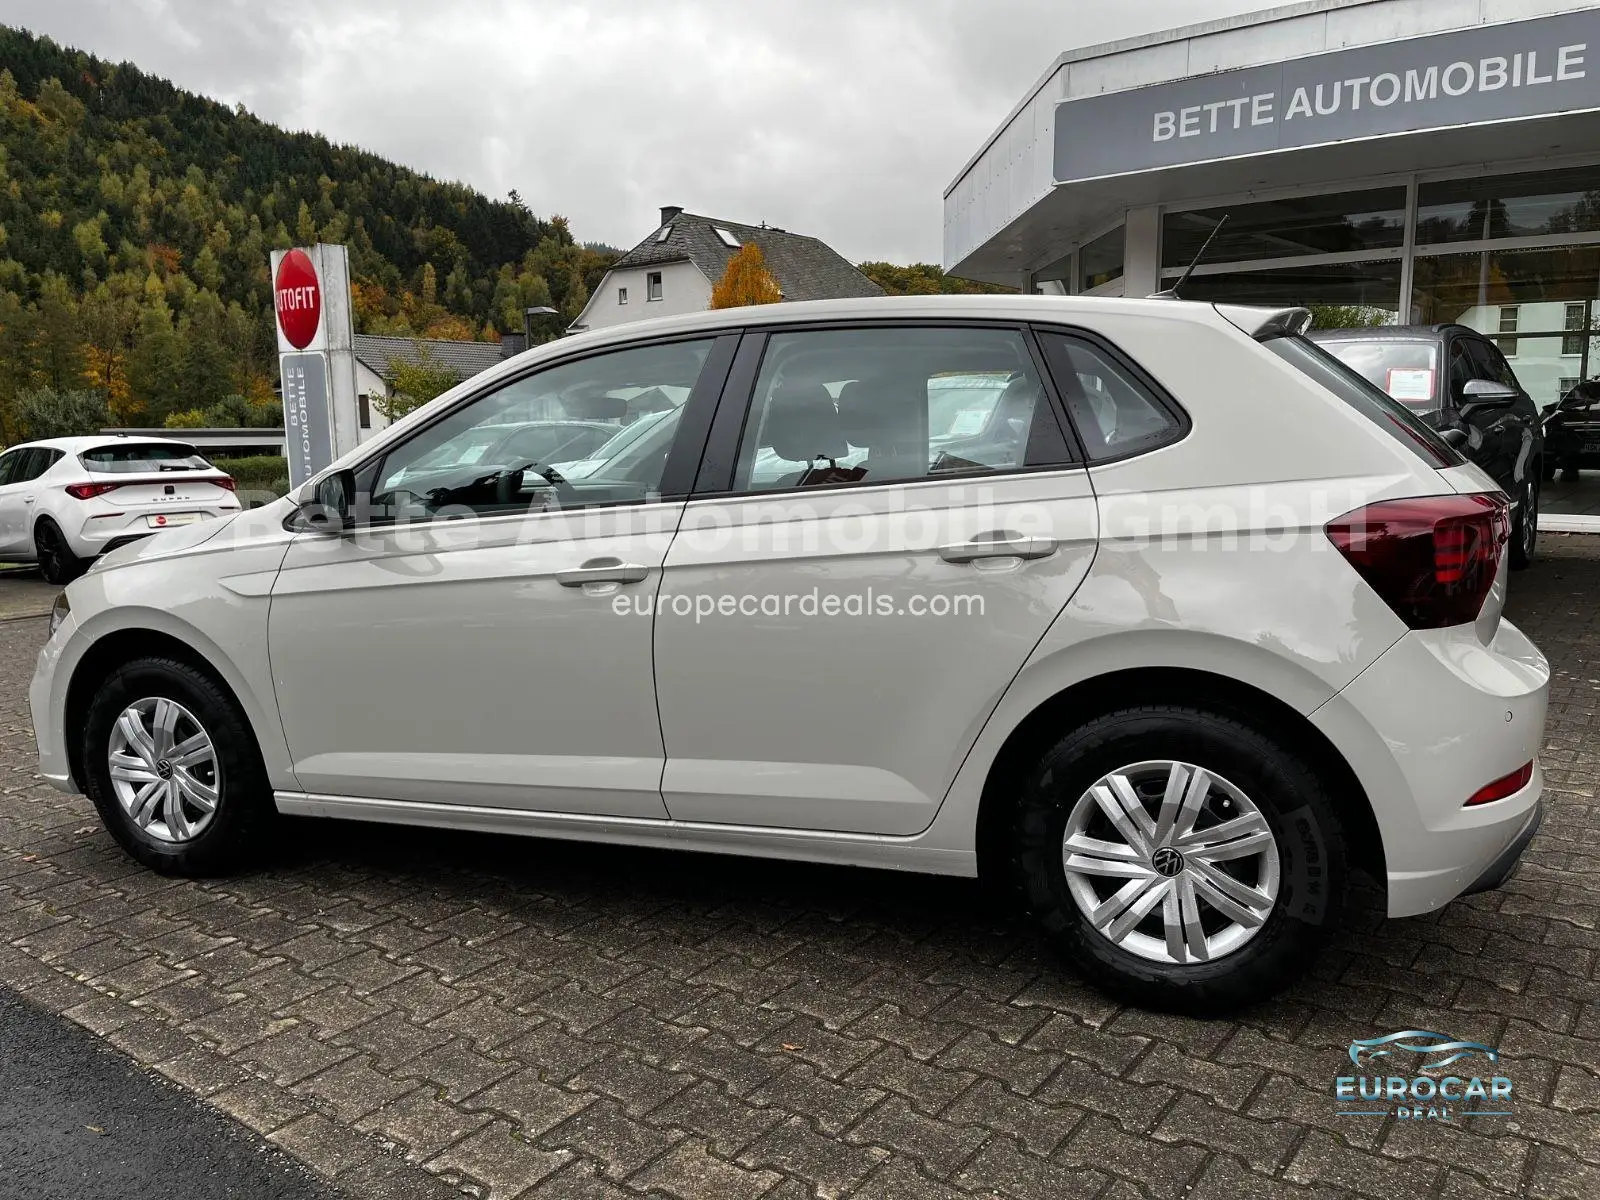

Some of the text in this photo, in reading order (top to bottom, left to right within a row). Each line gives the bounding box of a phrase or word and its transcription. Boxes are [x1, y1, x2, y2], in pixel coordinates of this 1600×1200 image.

[1152, 43, 1588, 142] BETTE AUTOMOBILE
[287, 367, 299, 427] BETTE
[297, 366, 312, 476] UTOMOBILE
